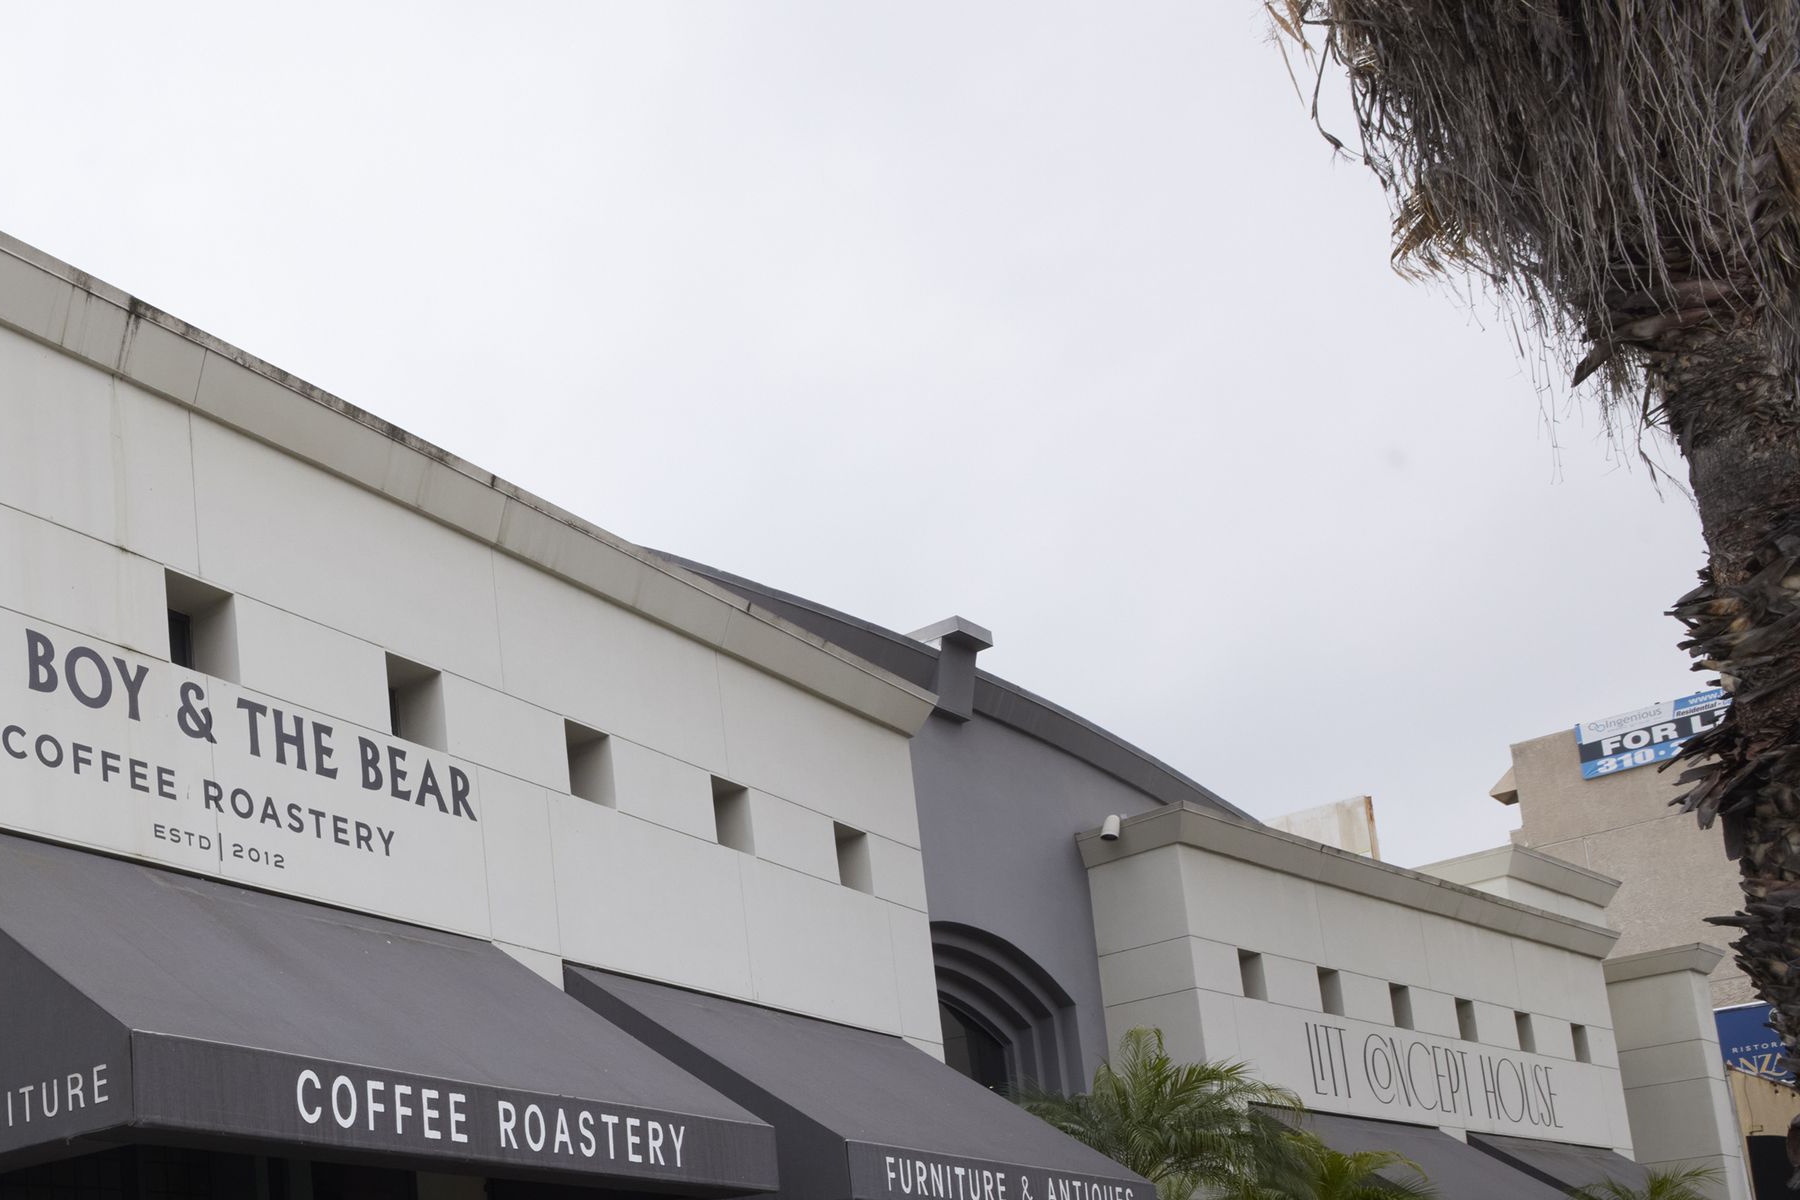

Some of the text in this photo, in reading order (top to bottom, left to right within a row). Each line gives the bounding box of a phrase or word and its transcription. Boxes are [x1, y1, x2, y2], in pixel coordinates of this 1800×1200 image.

[26, 628, 149, 721] BOY
[177, 681, 218, 744] &
[237, 697, 338, 779] THE
[358, 735, 477, 822] BEAR
[1601, 722, 1678, 756] FOR
[1605, 708, 1662, 729] Ingenious
[1676, 703, 1717, 717] Residential
[1, 725, 395, 856] COFFEE ROASTERY
[232, 843, 285, 869] 2012
[1305, 1022, 1564, 1129] LITT CONCEPT HOUSE
[296, 1068, 687, 1168] COFFEE ROASTERY
